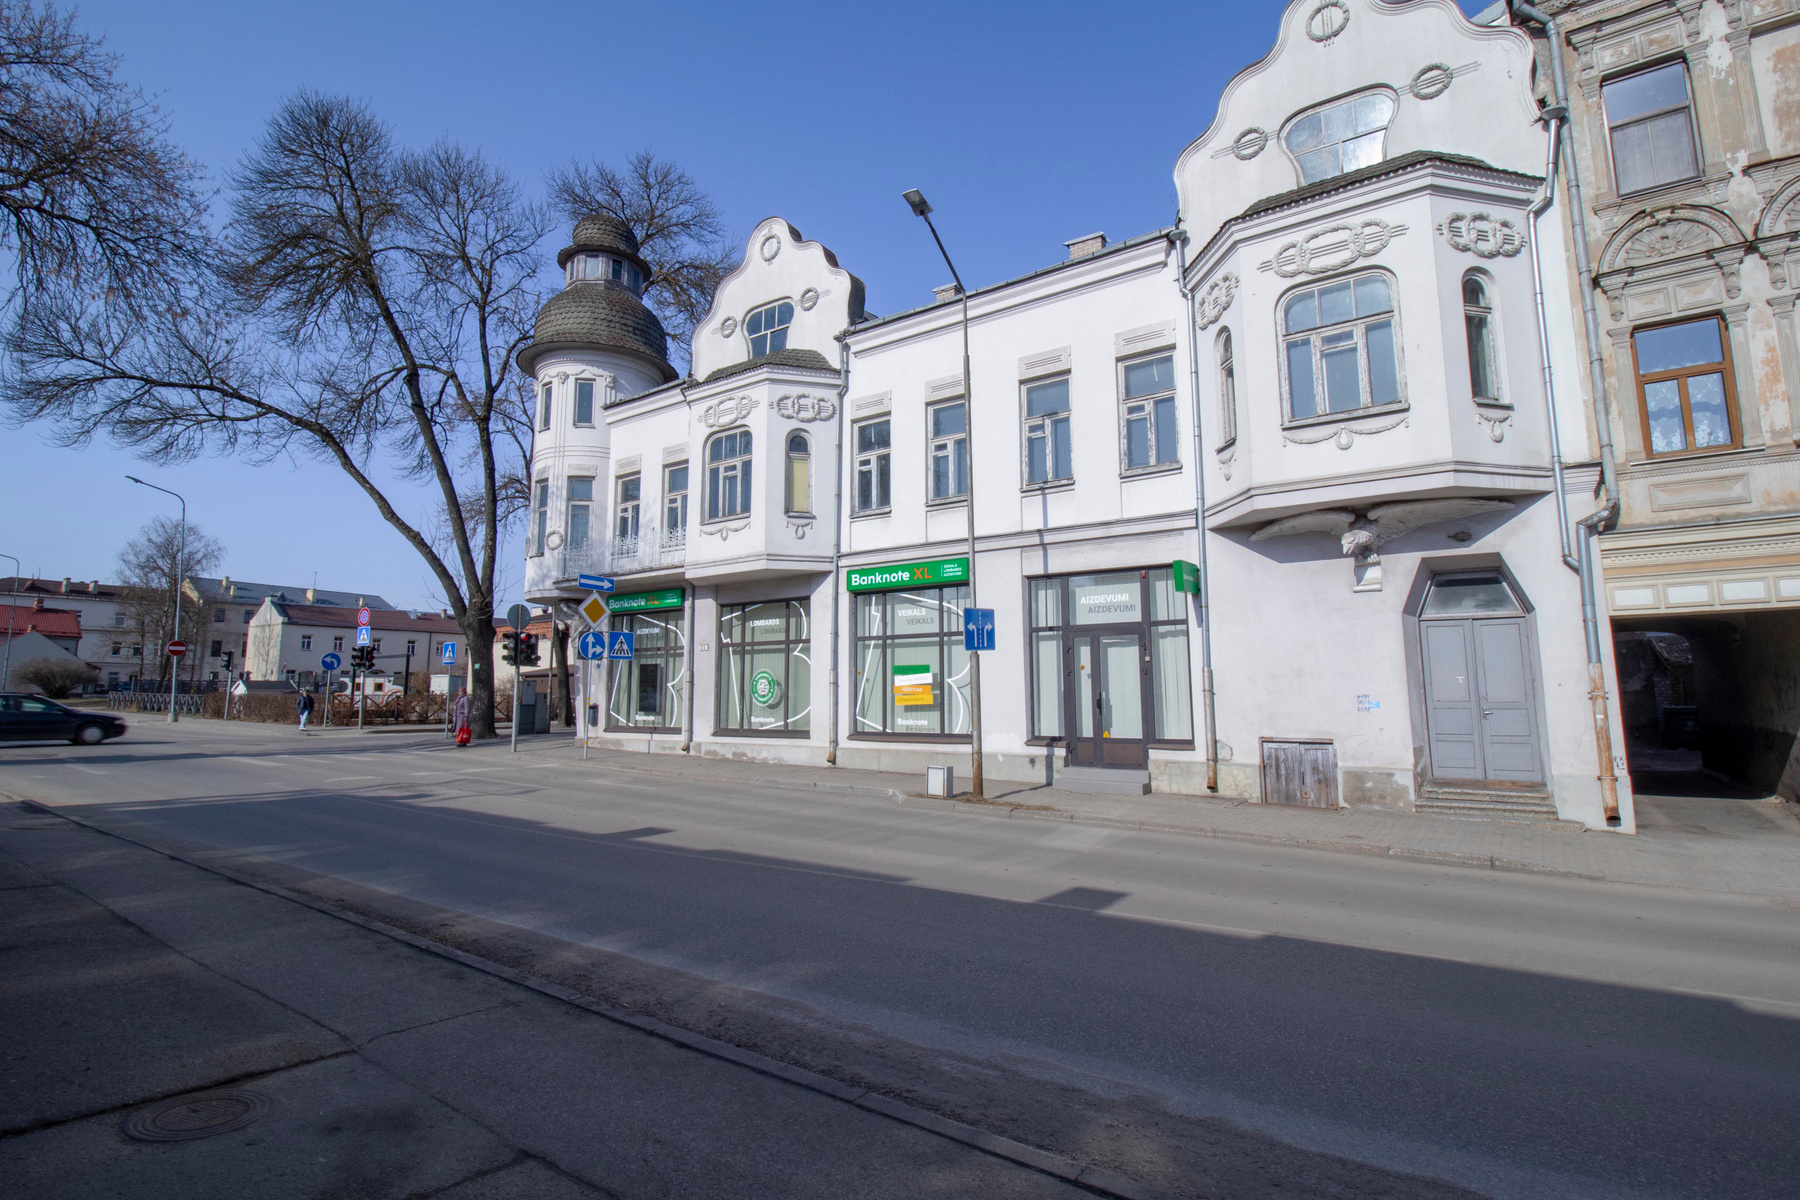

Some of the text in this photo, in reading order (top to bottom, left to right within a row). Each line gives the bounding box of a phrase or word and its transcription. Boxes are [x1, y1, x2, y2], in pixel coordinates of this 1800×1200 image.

[851, 566, 933, 586] Banknote XL
[608, 597, 646, 609] Banknote
[647, 595, 660, 605] XL
[1080, 593, 1129, 605] AIZDEVUMI
[897, 608, 926, 617] VEIKALS
[1087, 604, 1136, 614] AIZDEVUMI
[749, 618, 780, 627] LOMBARDS
[906, 617, 935, 626] VEIKALS
[897, 718, 929, 726] Banknote
